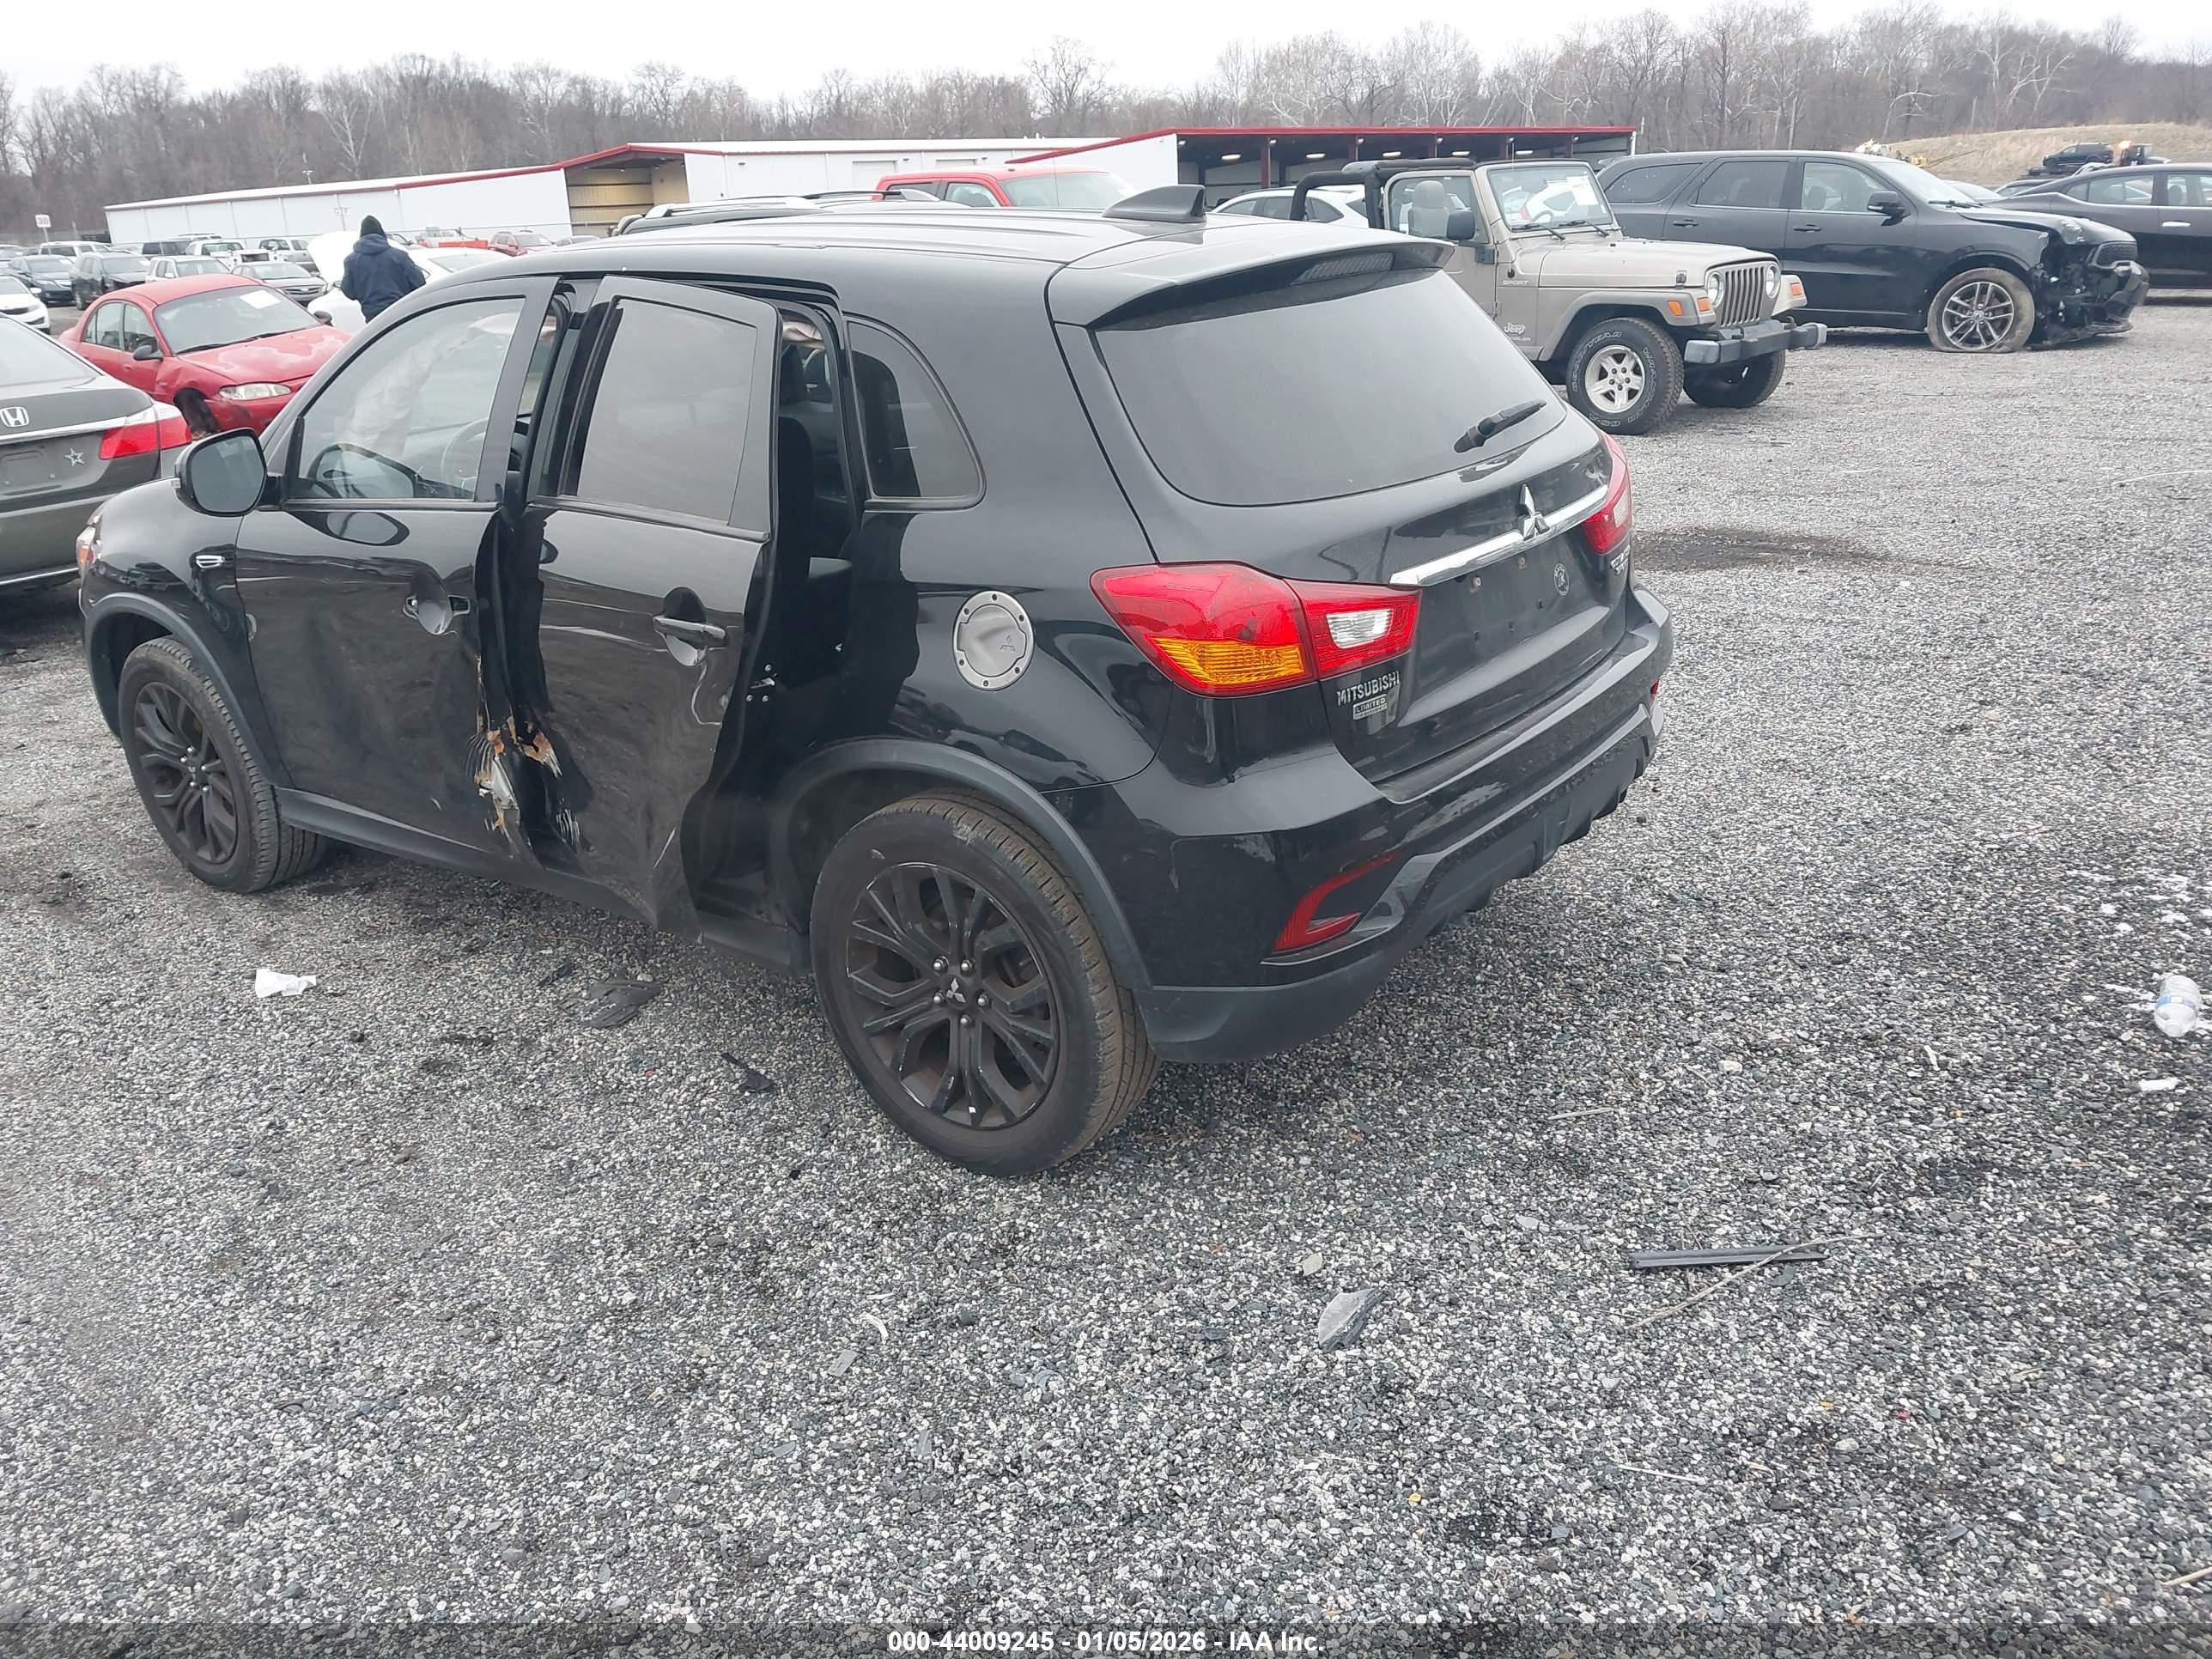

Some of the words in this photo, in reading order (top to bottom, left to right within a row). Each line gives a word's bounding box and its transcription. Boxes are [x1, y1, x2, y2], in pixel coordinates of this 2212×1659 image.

[1504, 322, 1526, 335] Jeep
[1336, 670, 1400, 706] MITSUBISHI
[1356, 697, 1387, 714] LIMITED
